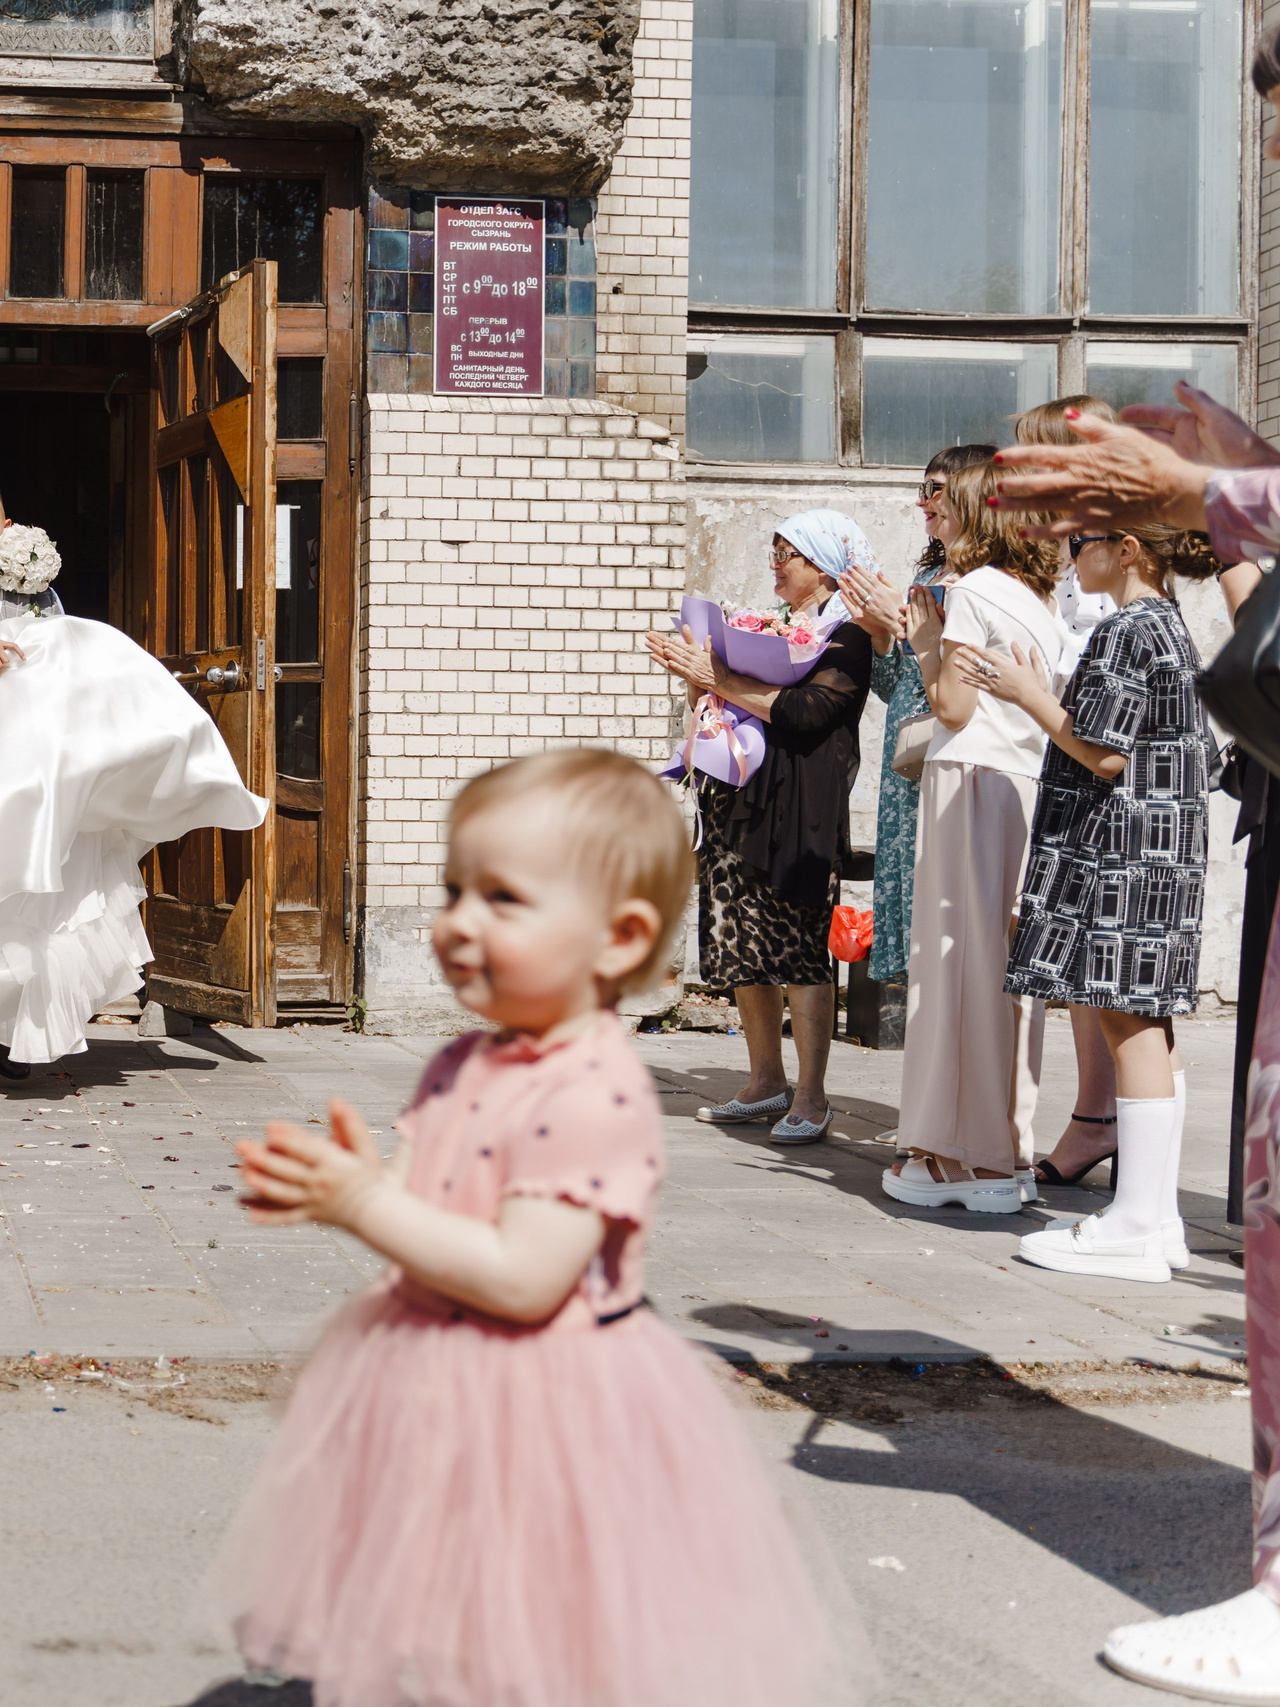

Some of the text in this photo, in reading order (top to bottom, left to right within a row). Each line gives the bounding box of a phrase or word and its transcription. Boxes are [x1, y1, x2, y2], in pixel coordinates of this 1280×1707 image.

[460, 206, 522, 216] ОТДЕЛ ЗАГС
[448, 219, 534, 230] ГОРОДСКОГО ОКРУГА
[450, 242, 532, 252] РЕЖИМ РАБОТЫ
[443, 262, 456, 270] ВТ
[443, 273, 458, 282] СР
[443, 284, 456, 292] ЧТ
[492, 284, 508, 298] до
[443, 296, 456, 304] ПТ
[443, 307, 458, 316] СБ
[469, 317, 508, 325] ПЕРЕРЫВ
[488, 334, 502, 345] до
[453, 364, 504, 372] САНИТАРНЫЙ
[450, 372, 494, 380] ПОСЛЕДНИЙ
